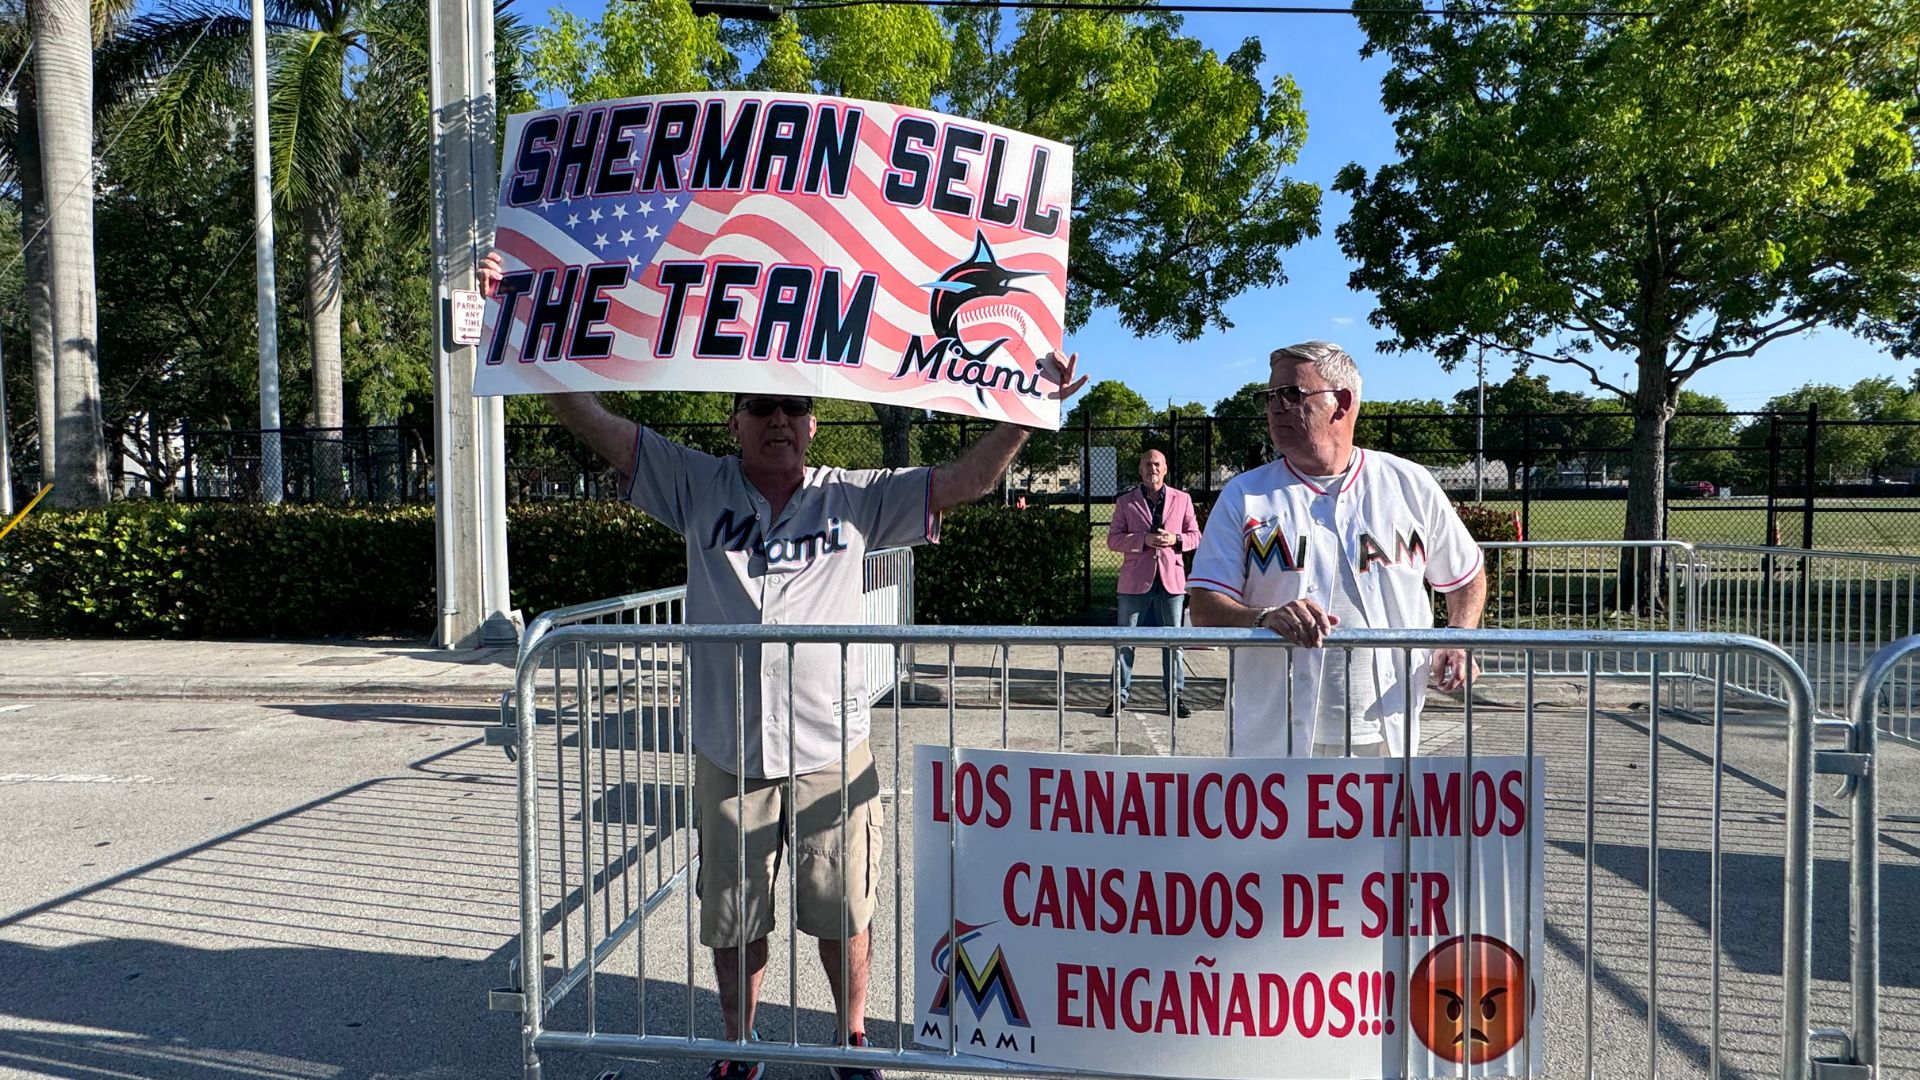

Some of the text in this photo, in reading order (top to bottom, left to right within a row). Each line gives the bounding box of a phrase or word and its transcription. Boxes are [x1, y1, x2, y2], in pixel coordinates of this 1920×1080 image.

[508, 99, 1065, 238] SHERMAN SELL
[486, 262, 880, 368] THE TEAM
[894, 334, 1043, 397] Miami
[932, 761, 1526, 839] LOS FANATICOS ESTAMOS
[1002, 861, 1451, 939] CANSADOS DE SER
[1056, 955, 1396, 1038] ENGAÑADOS!!!
[920, 1021, 1036, 1053] MIAMI
